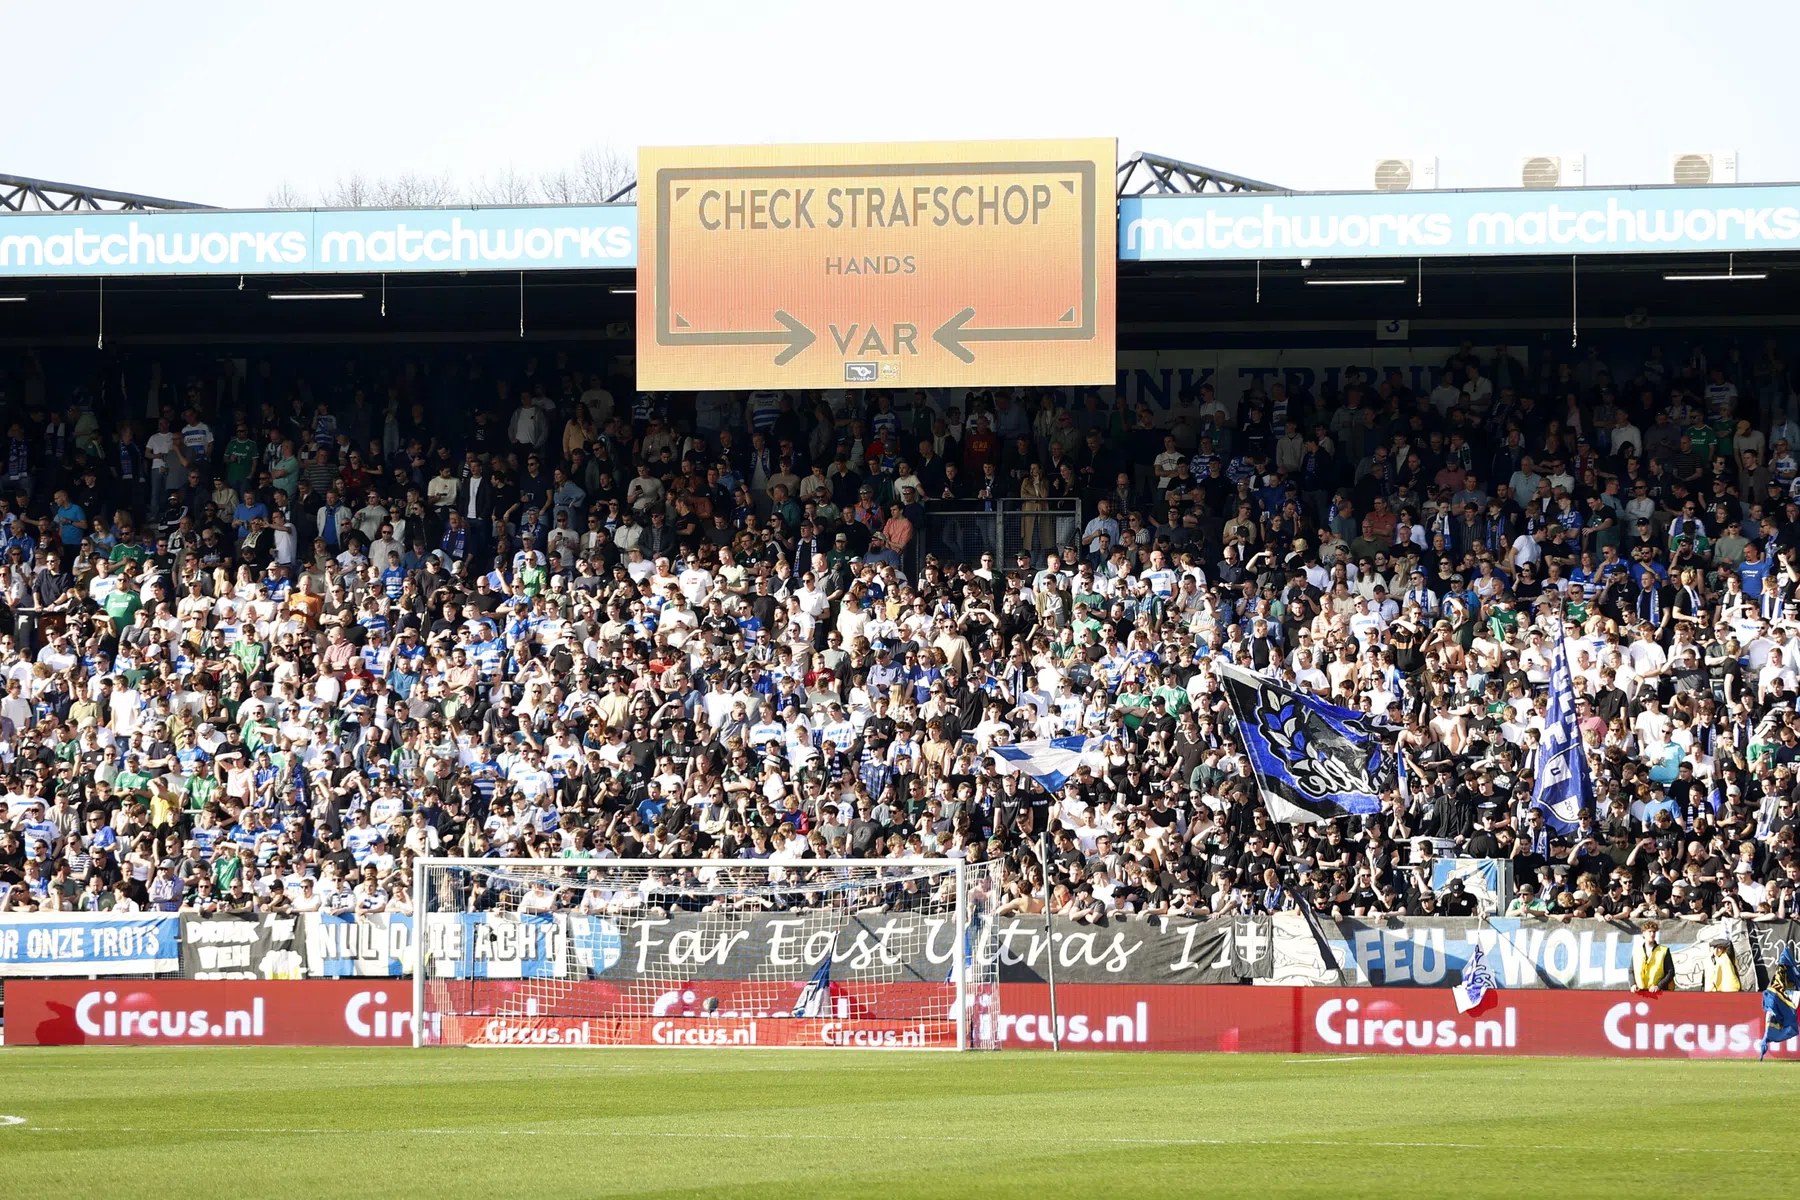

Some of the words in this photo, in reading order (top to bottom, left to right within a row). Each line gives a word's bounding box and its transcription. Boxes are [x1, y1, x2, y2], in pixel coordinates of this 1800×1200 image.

[699, 187, 817, 231] CHECK
[826, 184, 1051, 229] STRAFSCHOP
[1126, 202, 1452, 251] matchworks
[1467, 197, 1800, 246] matchworks
[0, 221, 307, 267] matchworks
[322, 217, 632, 264] matchworks
[825, 255, 917, 276] HANDS
[828, 322, 919, 356] VAR
[1385, 319, 1401, 334] 3
[26, 927, 85, 960] ONZE
[90, 924, 160, 958] TROTS
[186, 920, 260, 944] DRINK
[319, 922, 380, 961] NUL
[389, 922, 466, 961] DIE
[475, 922, 561, 962] ACHT
[632, 918, 749, 973] Far
[765, 918, 914, 970] East
[924, 915, 1143, 973] Ultras
[1355, 927, 1447, 985] FEU
[75, 991, 265, 1038] Circus.nl
[486, 1019, 590, 1045] Circus.nl
[652, 1021, 757, 1045] Circus.nl
[821, 1022, 926, 1047] Circus.nl
[1315, 998, 1517, 1047] Circus.nl
